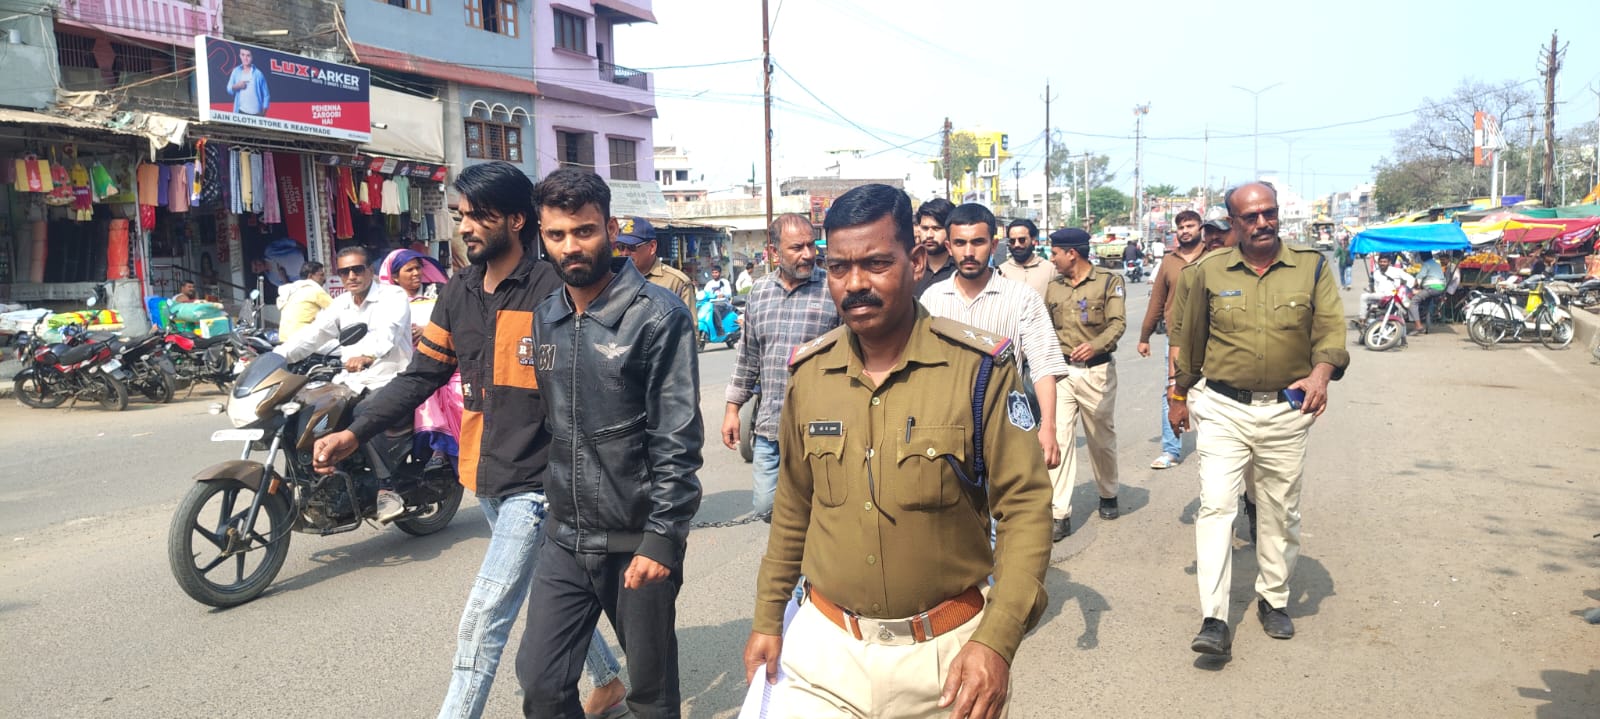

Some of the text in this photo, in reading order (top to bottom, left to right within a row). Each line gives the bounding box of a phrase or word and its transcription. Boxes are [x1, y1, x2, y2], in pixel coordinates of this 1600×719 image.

[270, 58, 310, 77] LUX
[311, 66, 359, 87] PARKER
[212, 112, 230, 121] JAIN
[232, 115, 257, 125] CLOTH
[259, 119, 282, 128] STORE
[290, 124, 332, 135] READYMADE
